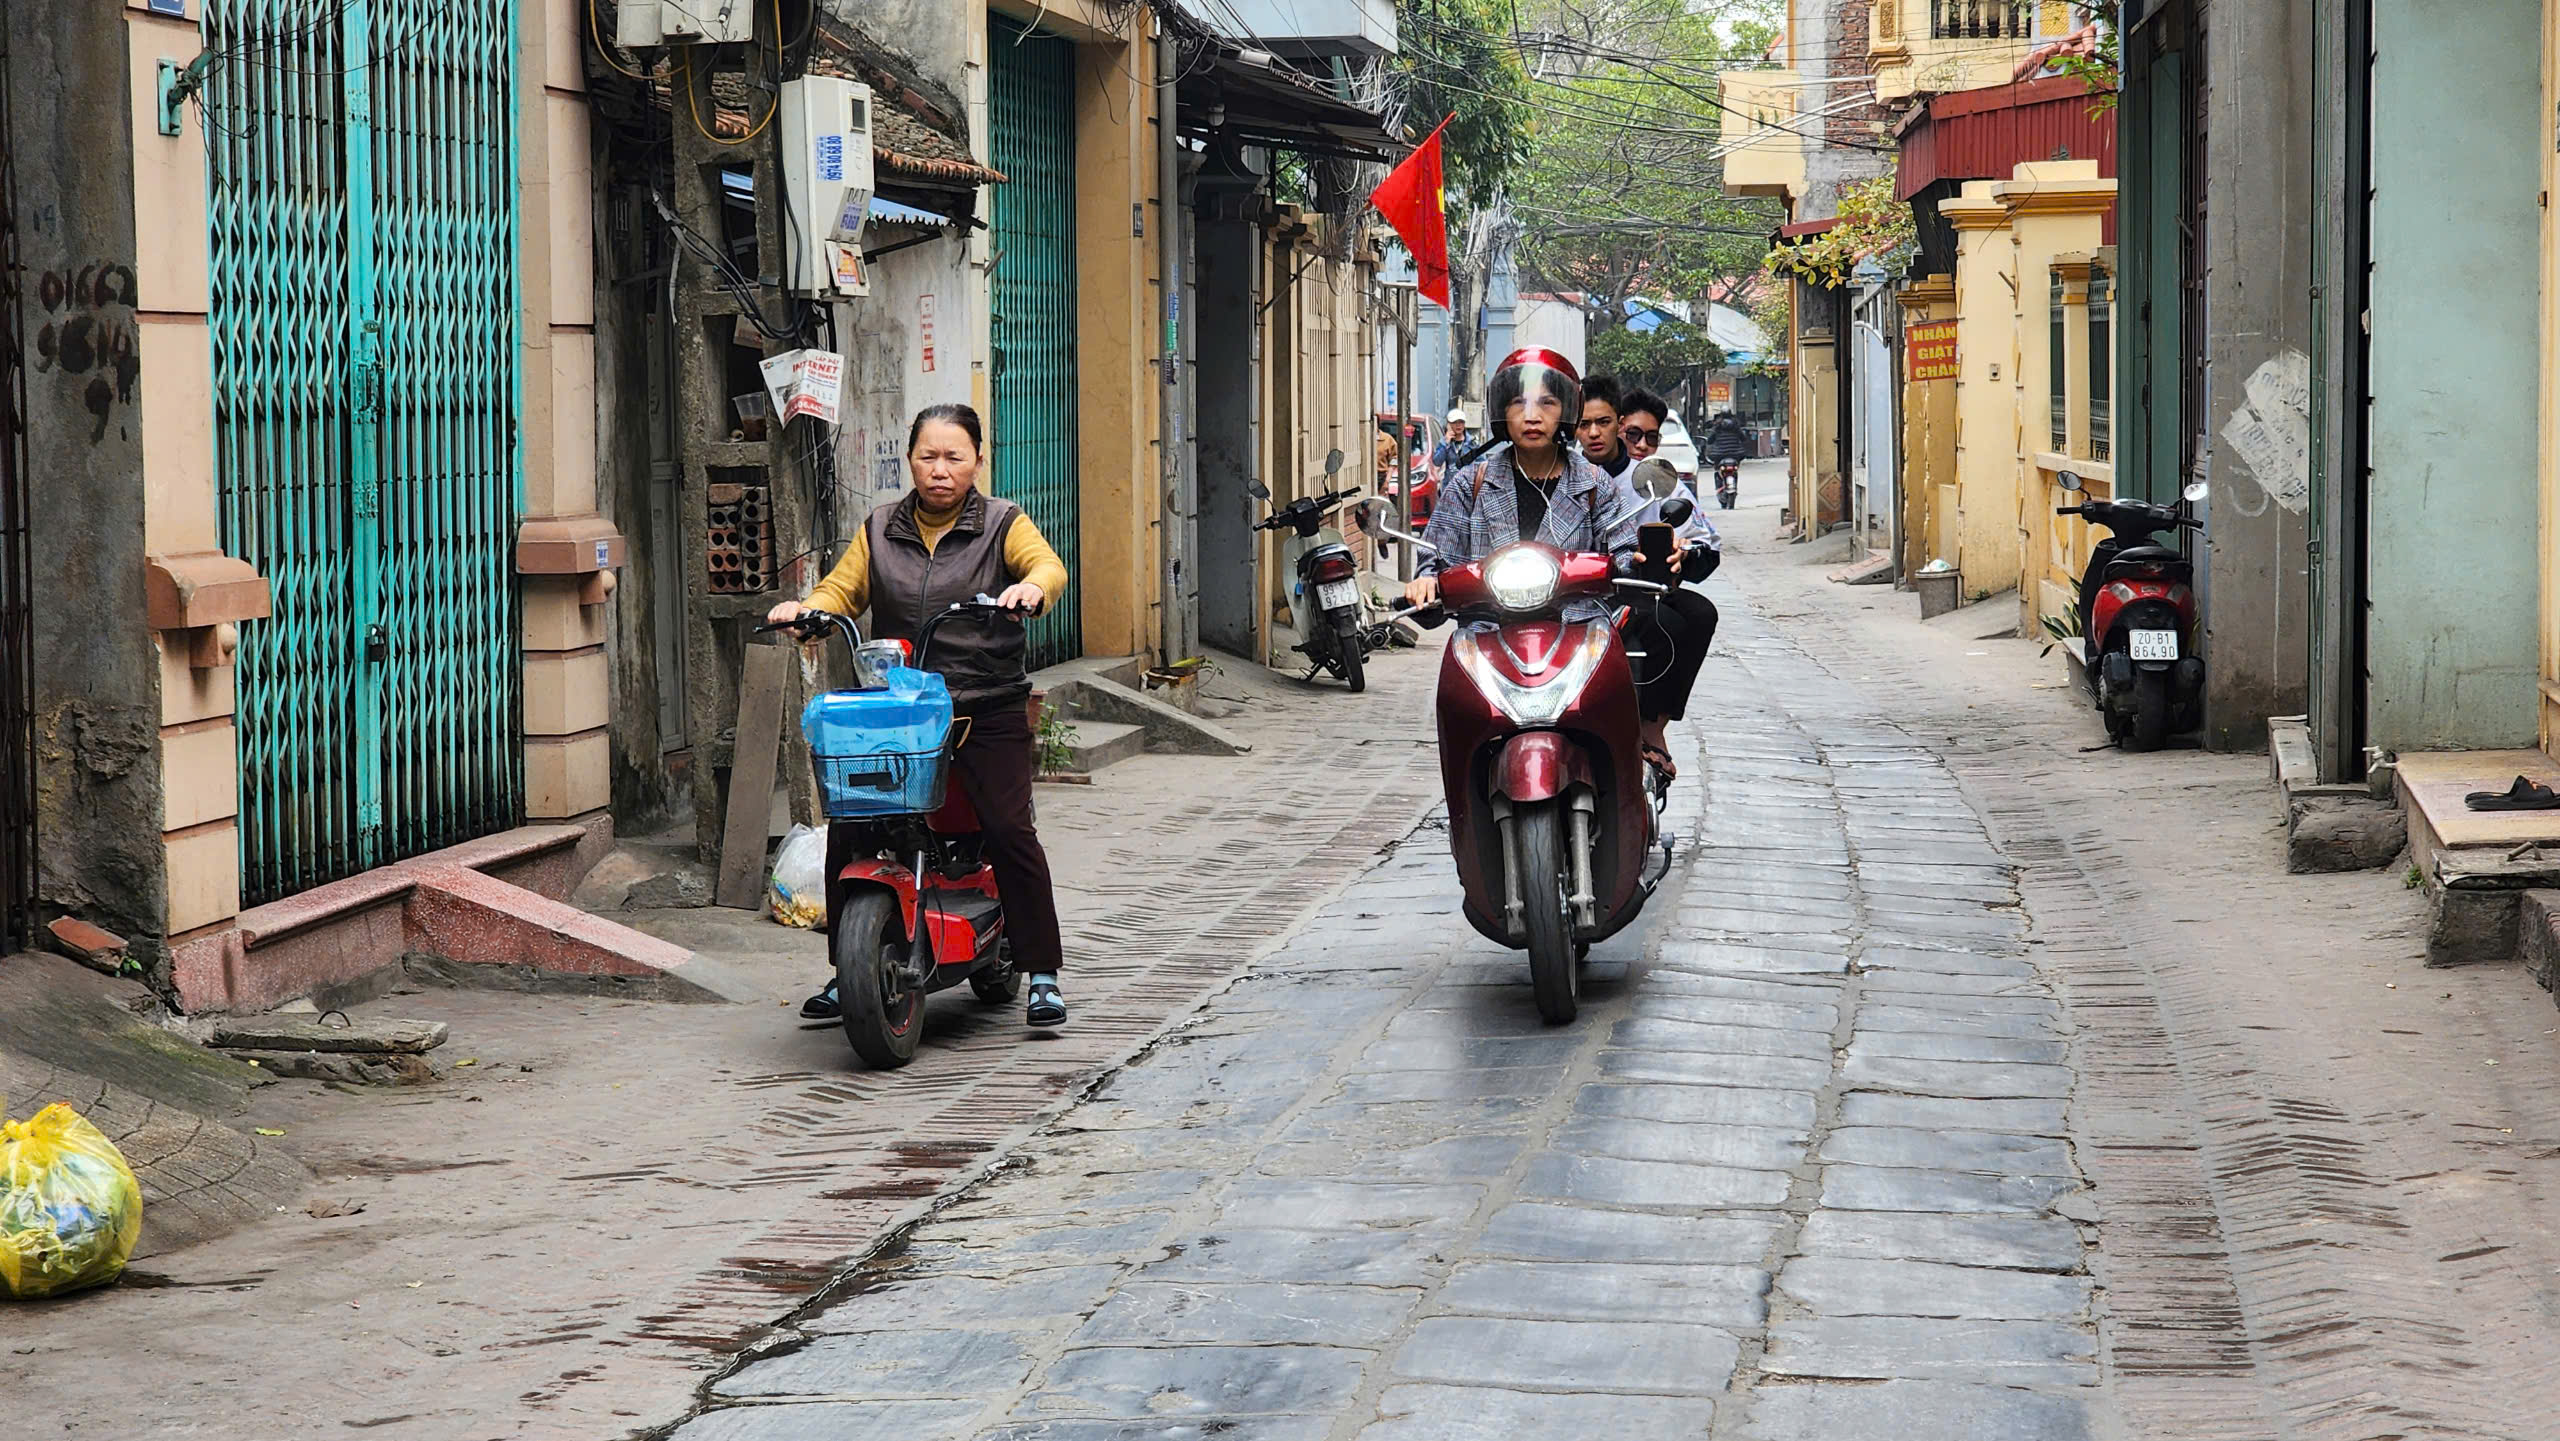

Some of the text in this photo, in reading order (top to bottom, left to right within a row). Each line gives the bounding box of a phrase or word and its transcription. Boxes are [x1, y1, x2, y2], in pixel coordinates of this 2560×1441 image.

[1912, 325, 1957, 342] NHẬN
[1917, 344, 1954, 361] GIẶT
[792, 359, 839, 374] INTERNET
[2134, 645, 2176, 658] 864.90
